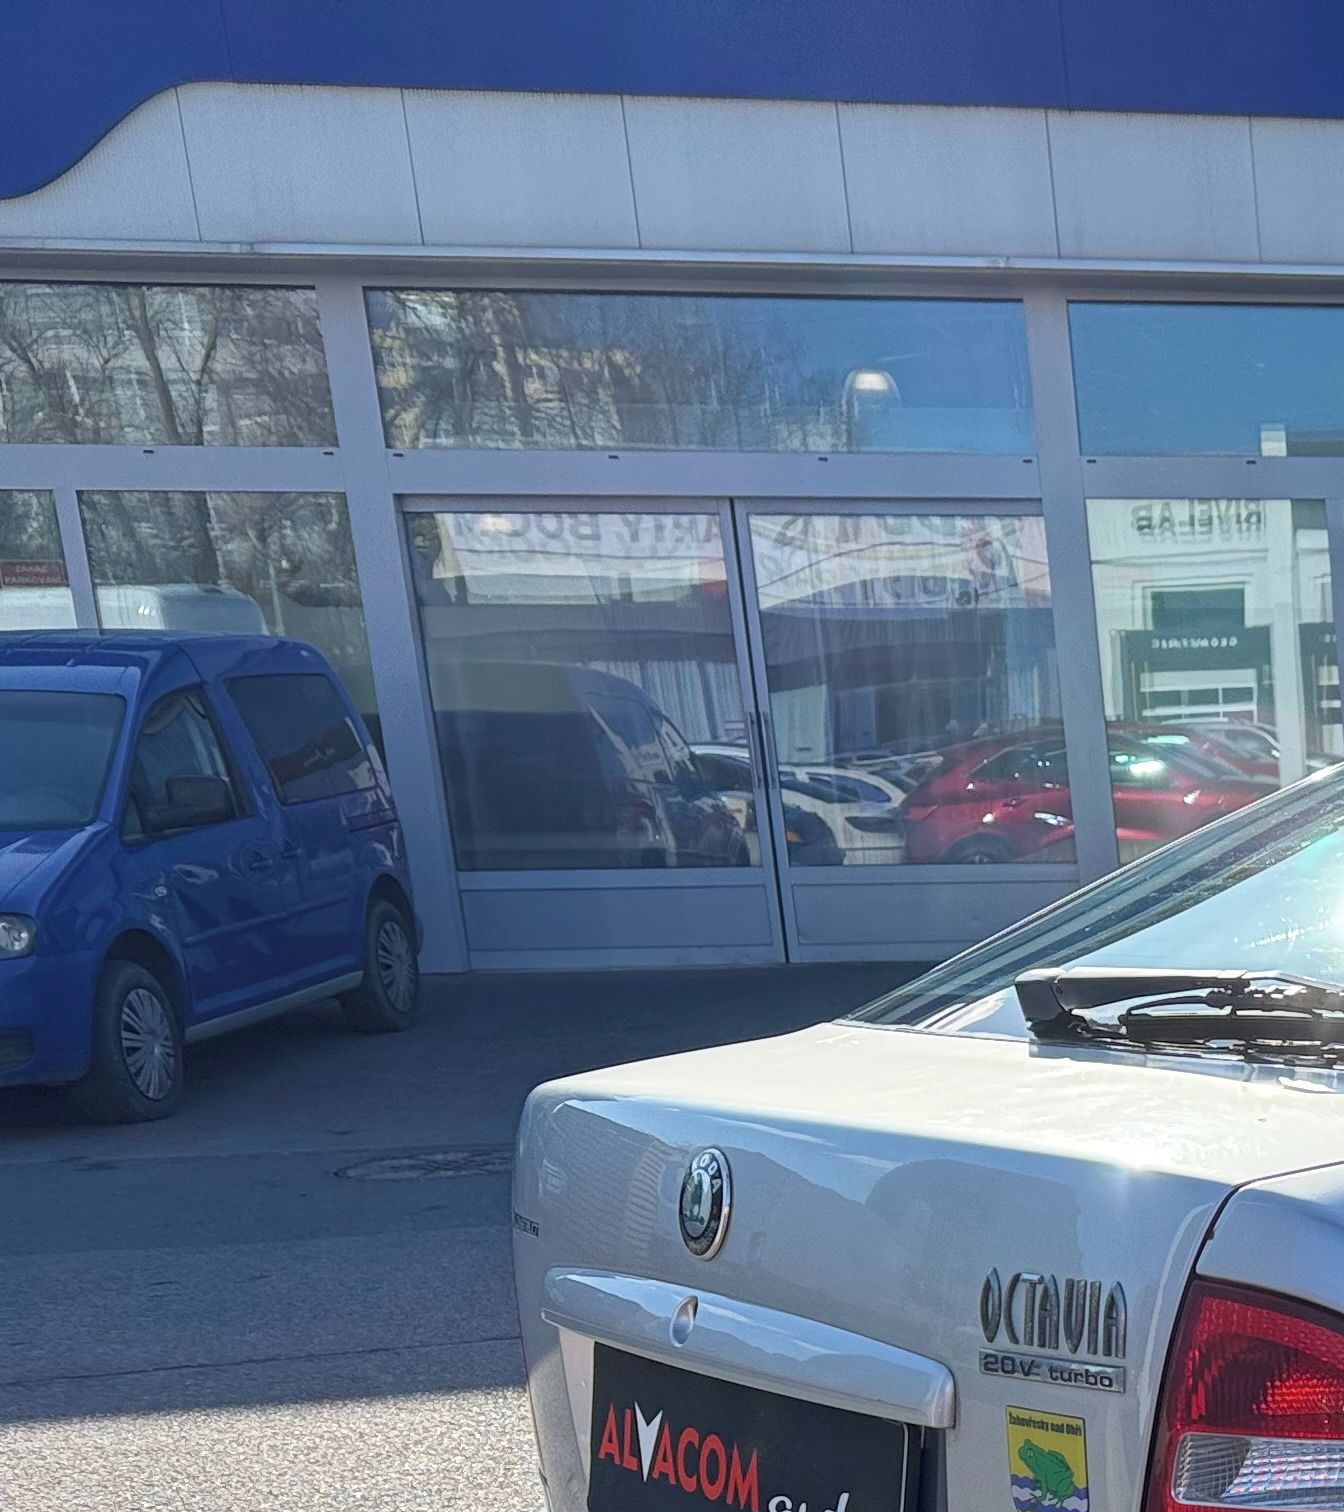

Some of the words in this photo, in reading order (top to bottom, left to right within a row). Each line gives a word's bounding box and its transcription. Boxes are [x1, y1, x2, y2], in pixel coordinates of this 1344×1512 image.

[979, 1266, 1128, 1360] OCTAVIA
[982, 1353, 1036, 1377] 20V
[1047, 1364, 1115, 1389] turbo
[1050, 1421, 1065, 1434] nad
